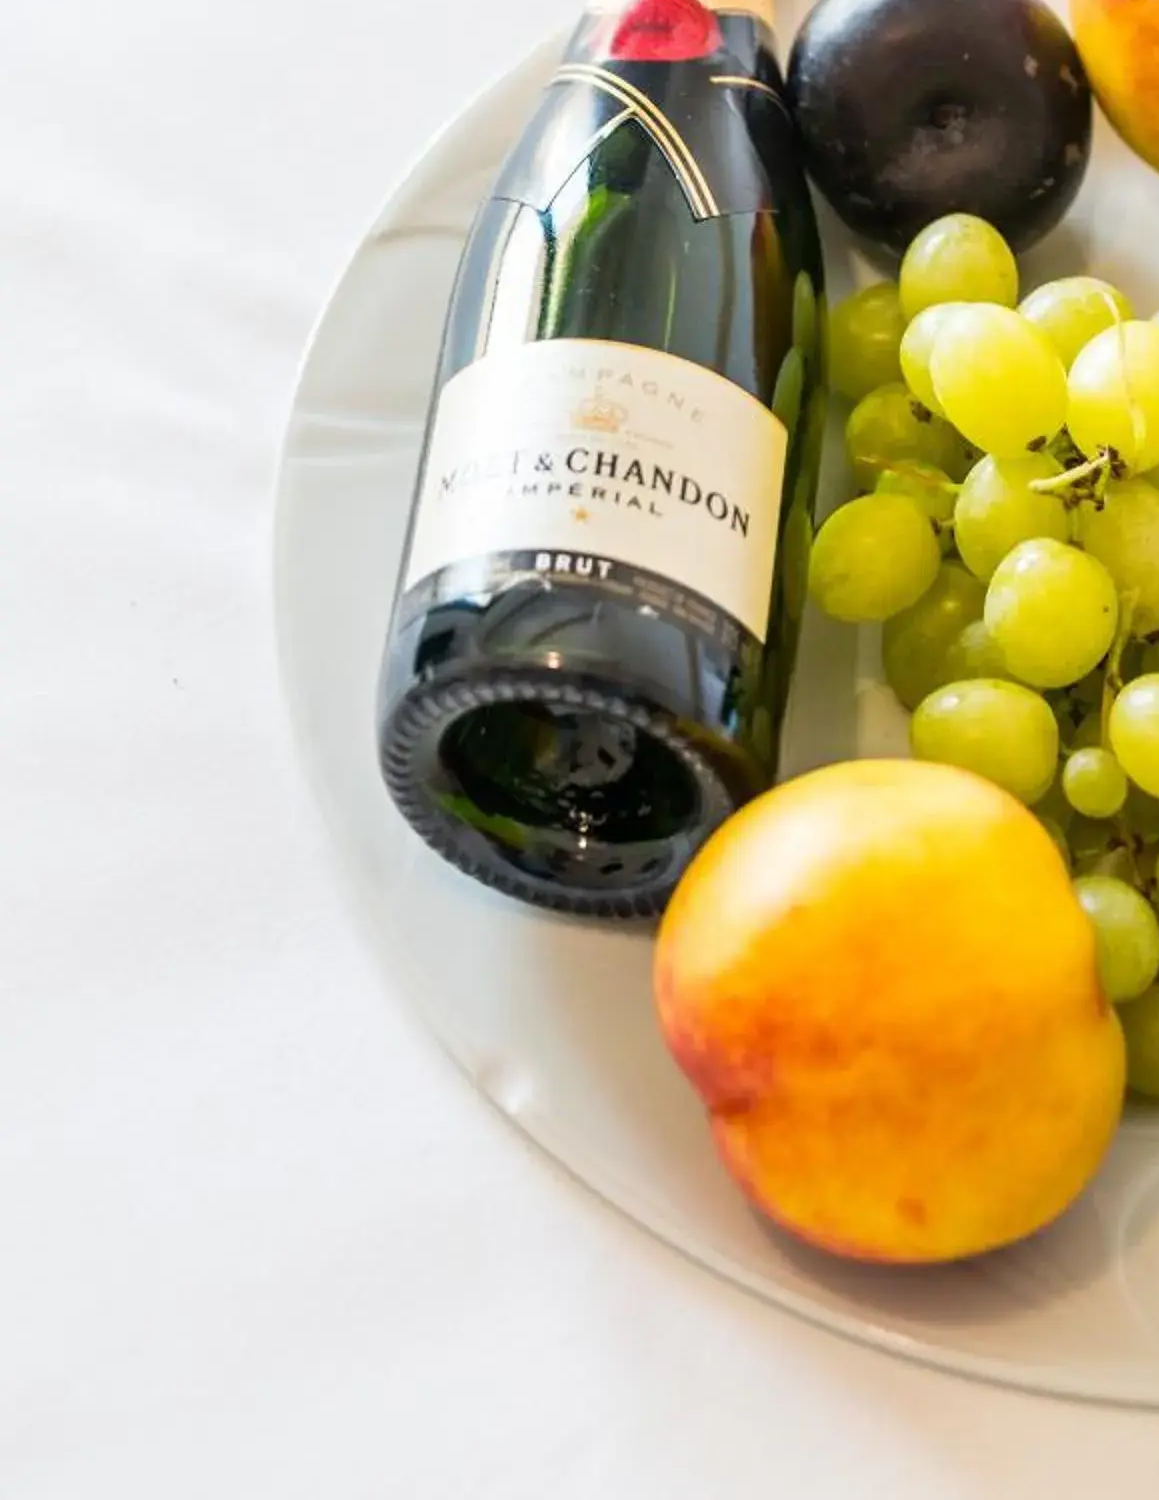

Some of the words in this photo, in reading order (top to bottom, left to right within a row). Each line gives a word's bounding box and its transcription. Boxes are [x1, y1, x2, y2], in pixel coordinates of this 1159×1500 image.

[534, 453, 554, 471] &
[565, 447, 751, 539] CHANDON
[535, 552, 613, 580] BRUT
